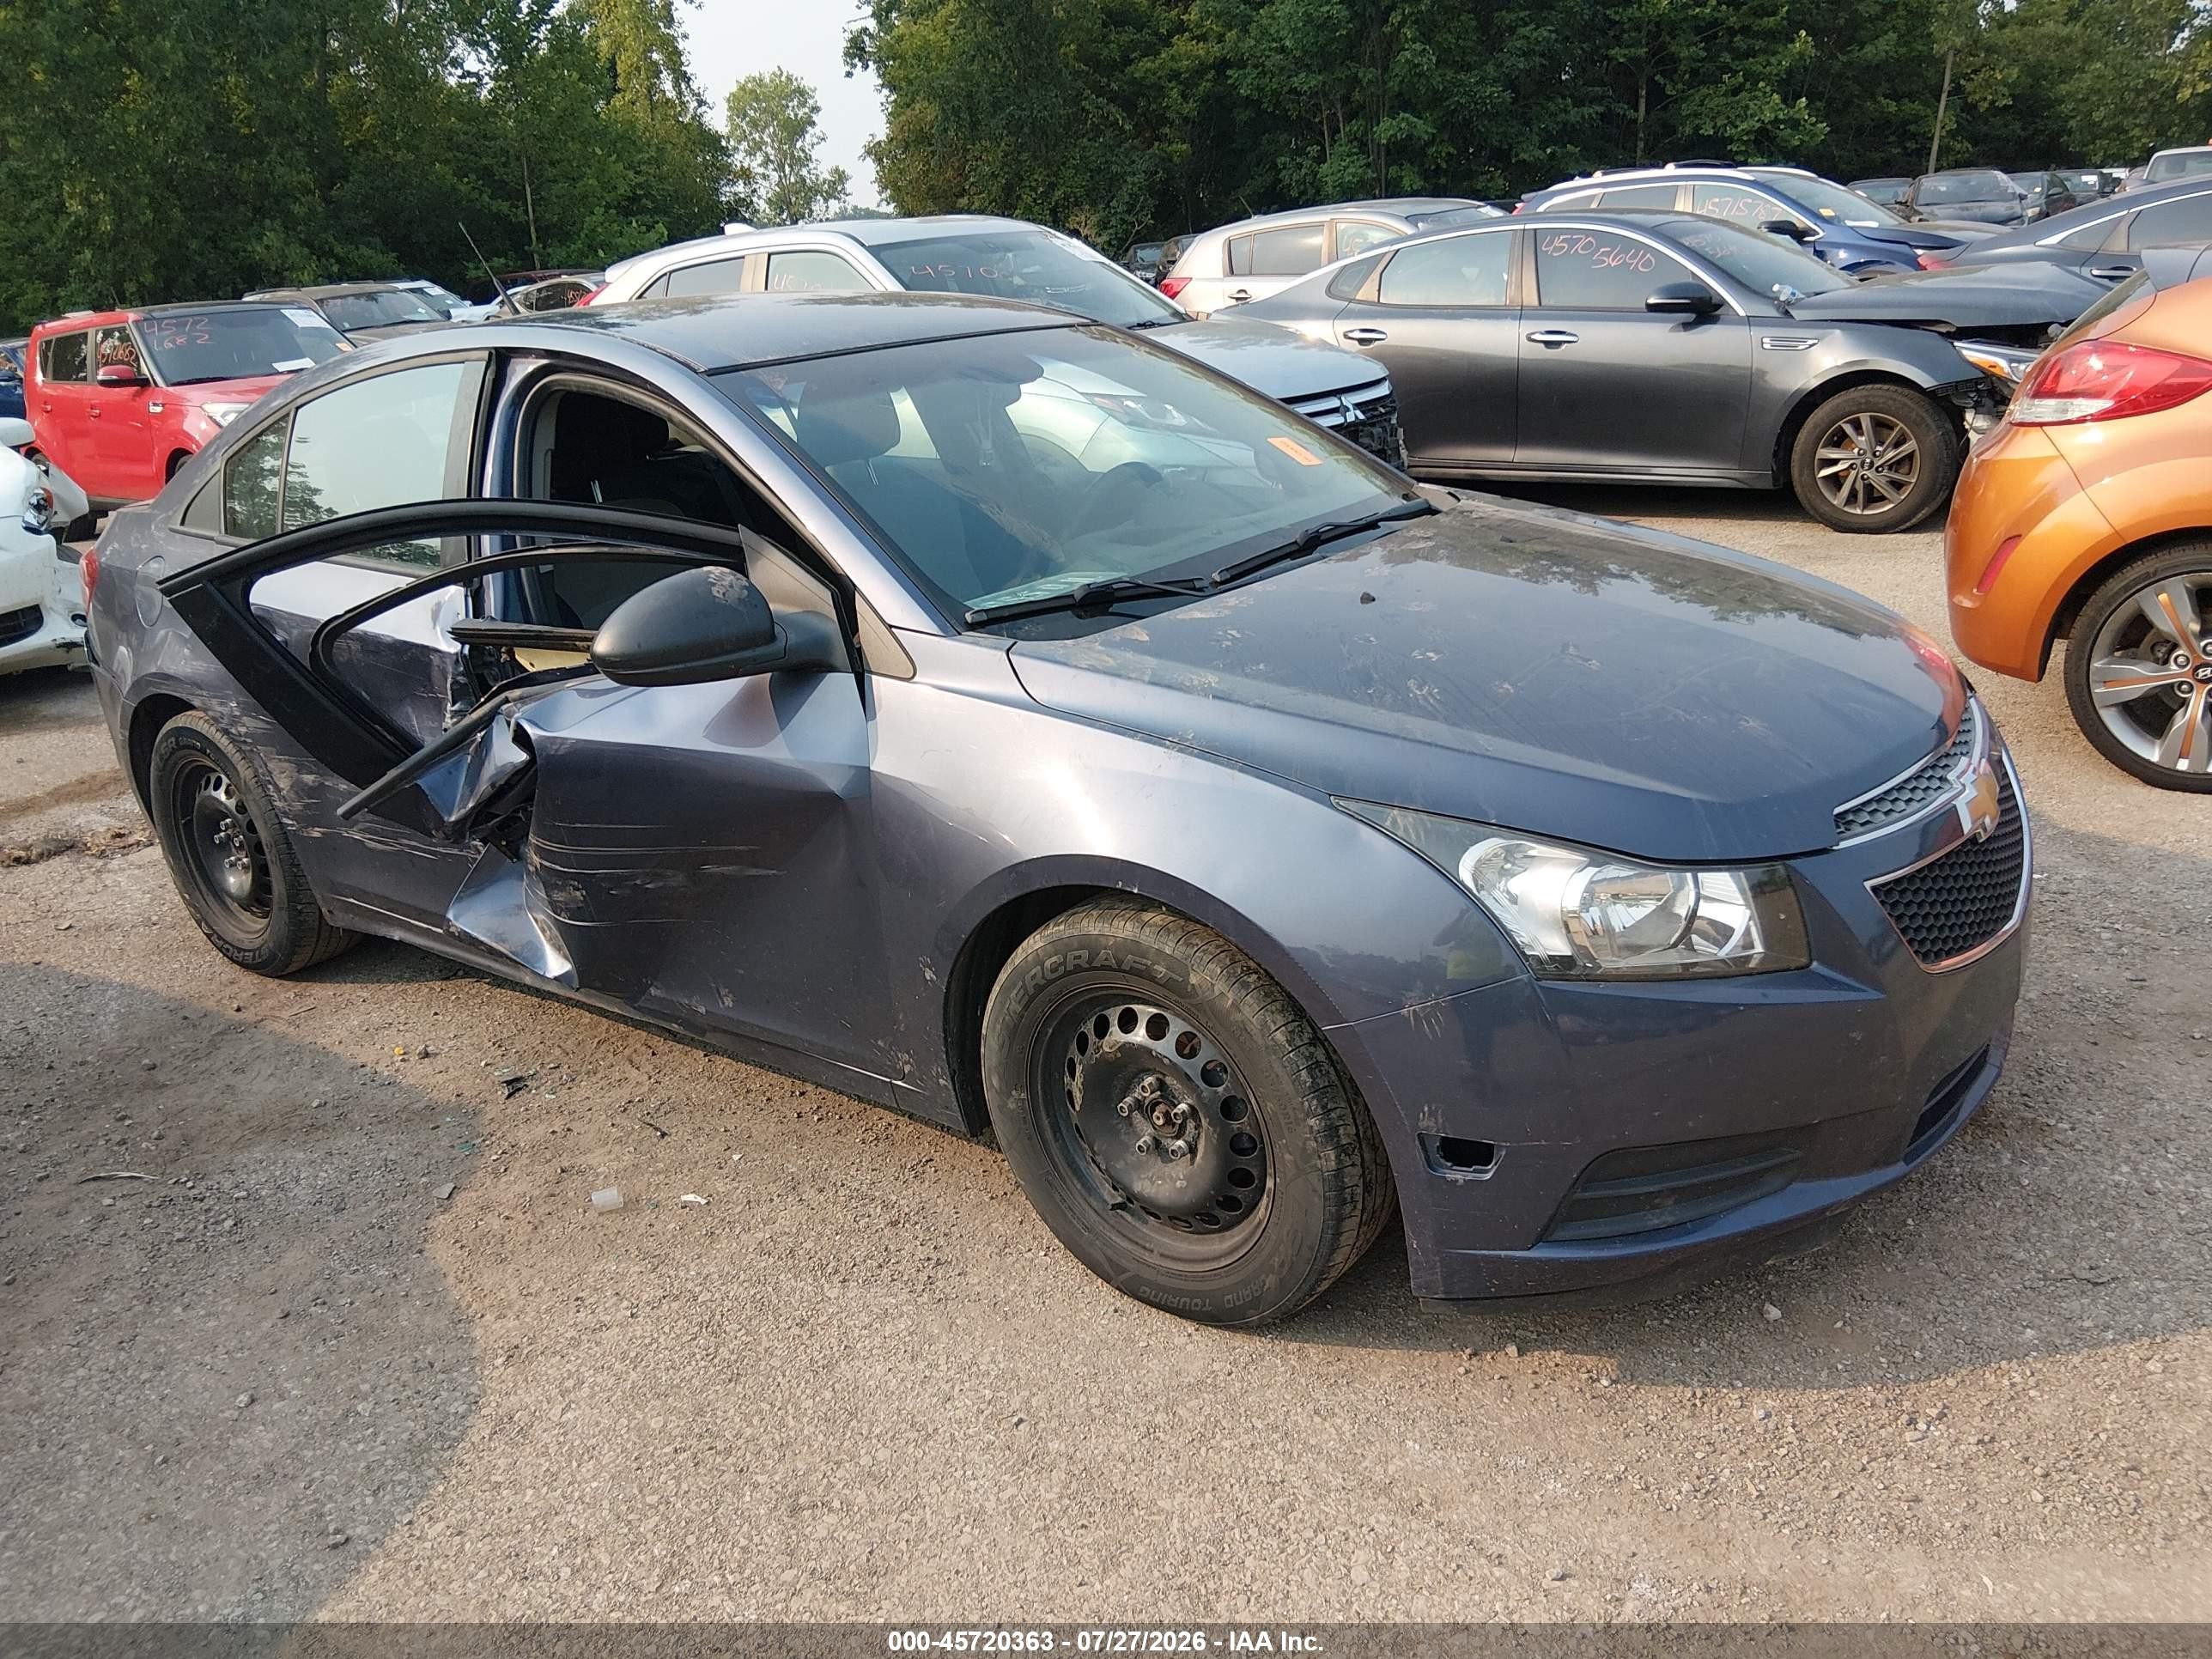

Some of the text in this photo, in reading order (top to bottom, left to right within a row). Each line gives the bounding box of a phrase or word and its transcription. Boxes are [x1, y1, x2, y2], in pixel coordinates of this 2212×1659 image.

[1541, 234, 1595, 257] 4570
[1590, 244, 1656, 272] 5640
[143, 316, 212, 336] 4572
[154, 332, 214, 351] 1682
